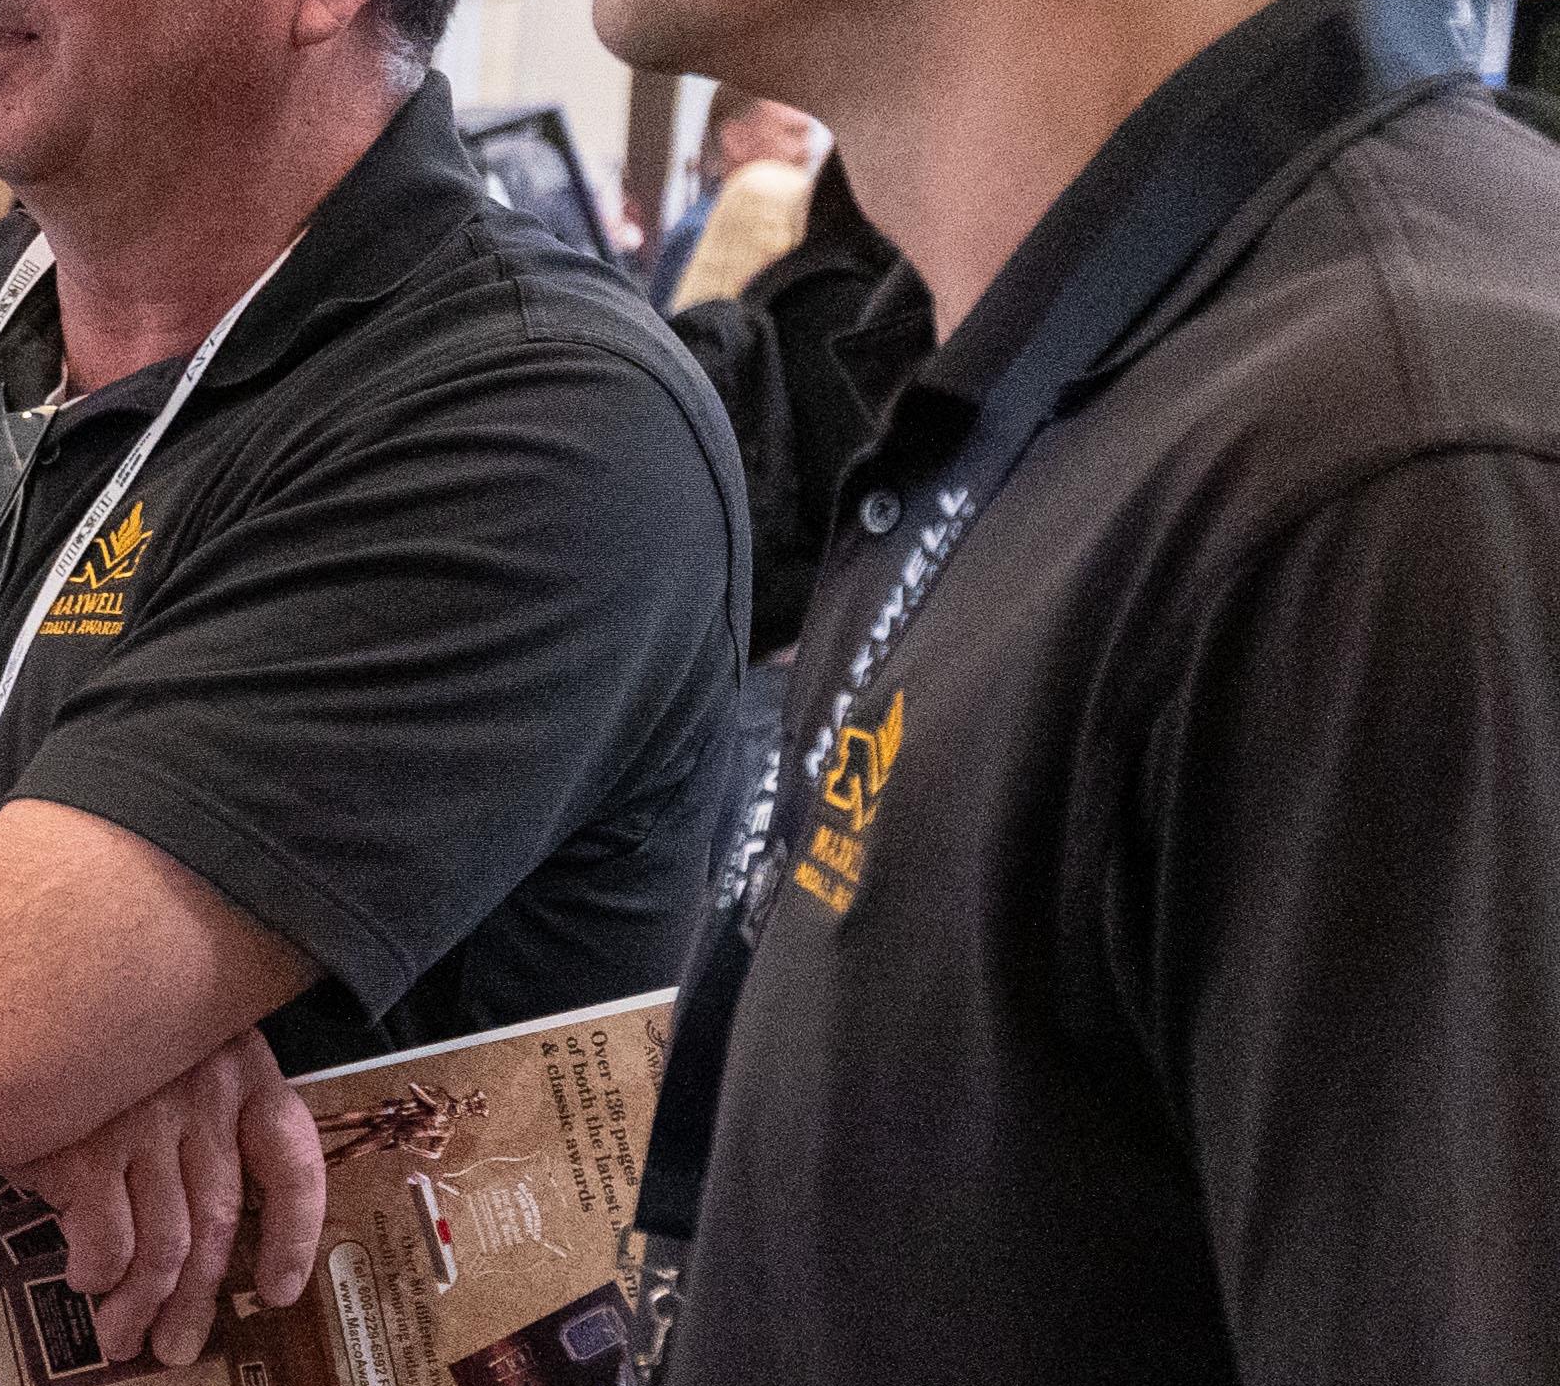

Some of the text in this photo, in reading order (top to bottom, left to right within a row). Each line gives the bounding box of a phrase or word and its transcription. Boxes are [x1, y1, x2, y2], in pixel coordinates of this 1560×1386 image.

[40, 621, 69, 635] EDALS
[564, 1034, 585, 1061] of
[571, 1060, 598, 1113] both
[589, 1029, 616, 1081] Over
[607, 1126, 639, 1188] pages
[540, 1039, 598, 1215] & classic awards
[584, 1115, 608, 1152] the
[593, 1153, 623, 1214] latest
[356, 1286, 387, 1376] 800-229-6592
